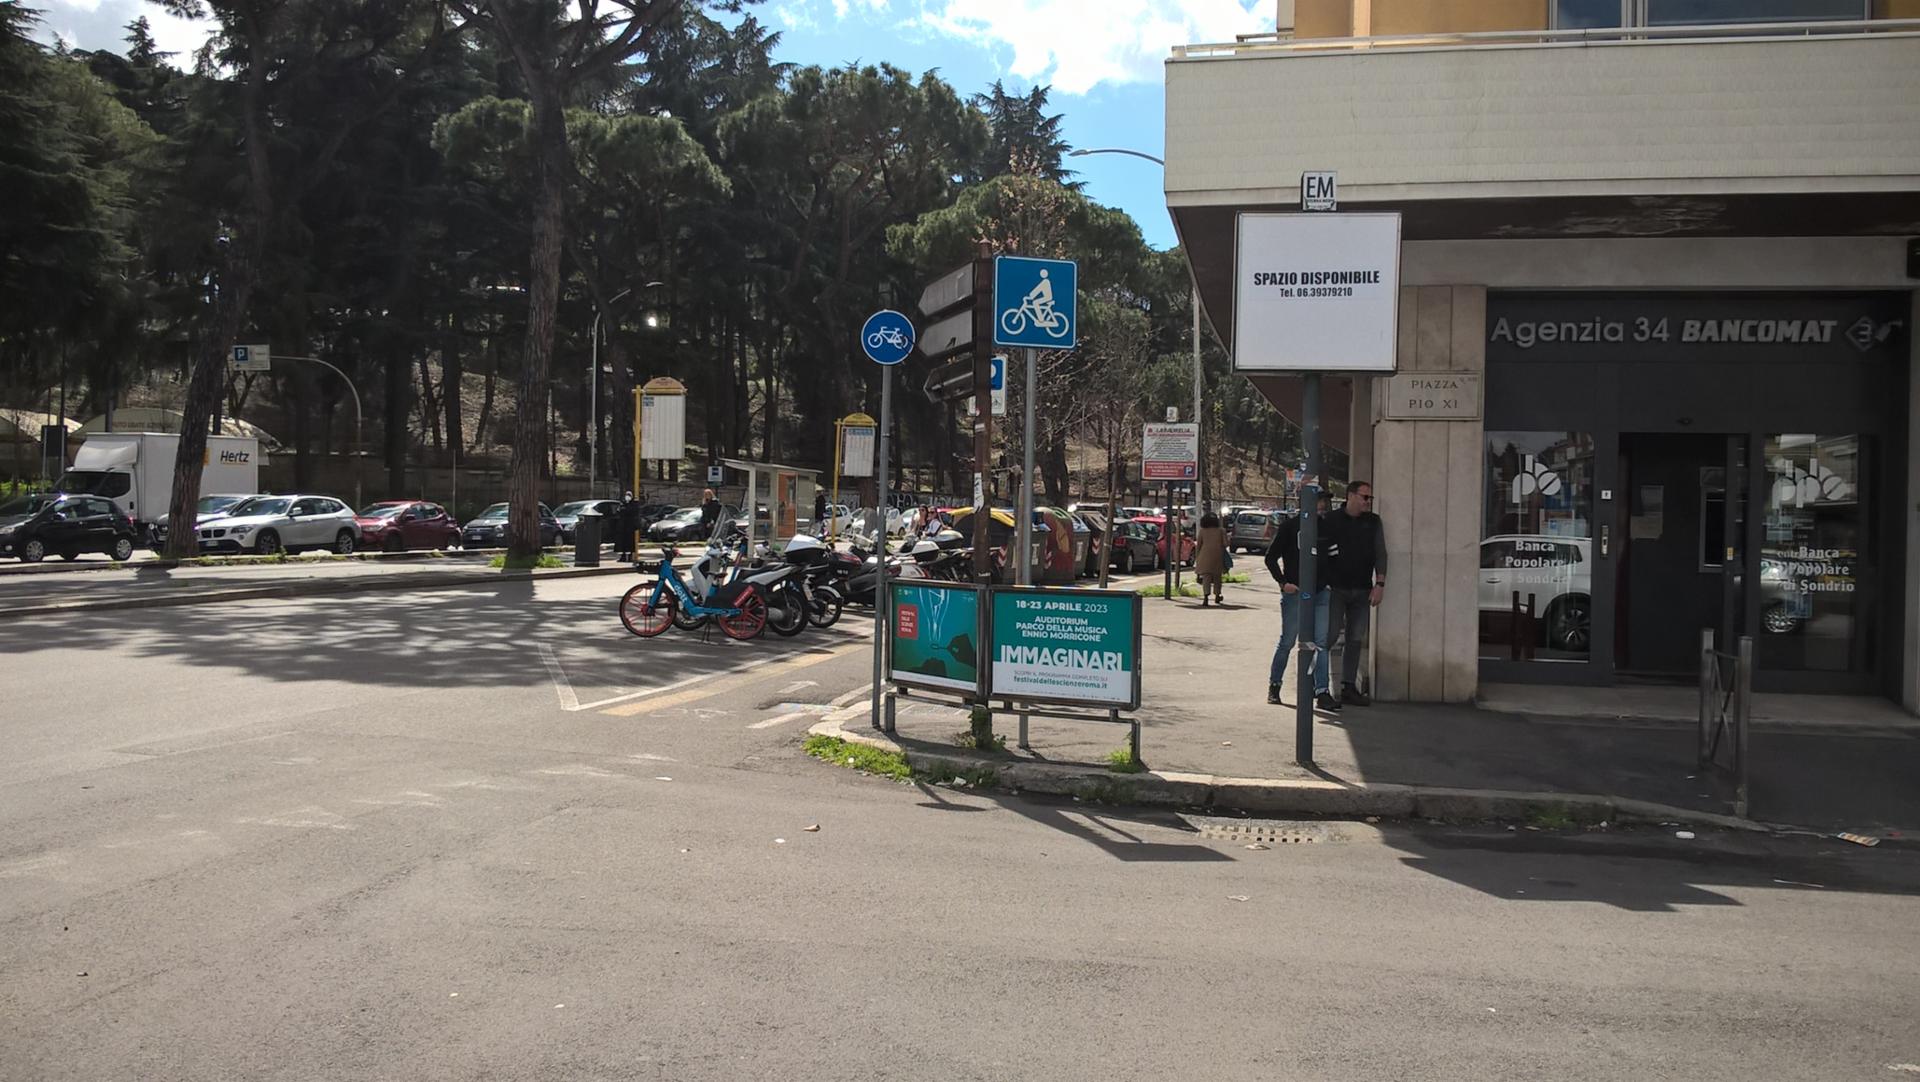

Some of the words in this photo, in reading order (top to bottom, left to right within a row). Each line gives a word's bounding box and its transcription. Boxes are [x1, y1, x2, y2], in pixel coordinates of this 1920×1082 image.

[1306, 176, 1334, 198] EM
[1253, 272, 1297, 286] SPAZIO
[1300, 270, 1380, 285] DISPONIBILE
[1280, 288, 1295, 298] Tel.
[1296, 286, 1353, 298] 06.39379210
[1490, 316, 1624, 348] Agenzia
[1633, 316, 1670, 342] 34
[1681, 319, 1838, 342] BANCOMAT
[1411, 380, 1458, 389] PIAZZA
[1409, 399, 1434, 409] PIO
[1443, 399, 1458, 409] XI
[220, 450, 249, 463] Hertz
[1515, 540, 1555, 552] Banca
[1799, 546, 1840, 559] Banca
[1505, 556, 1565, 569] Popolare
[1789, 562, 1850, 576] Popolare
[1783, 579, 1796, 591] di
[1800, 579, 1855, 592] Sondrio
[1044, 602, 1082, 612] APRILE
[1084, 603, 1108, 613] 2023
[1034, 615, 1088, 626] AUDITORIUM
[1015, 622, 1045, 631] PARCO
[1046, 624, 1073, 633] DELLA
[1074, 625, 1108, 635] MUSICA
[1022, 630, 1048, 639] ENNIO
[1050, 631, 1101, 642] MORRICONE
[1000, 644, 1123, 672] IMMAGINARI
